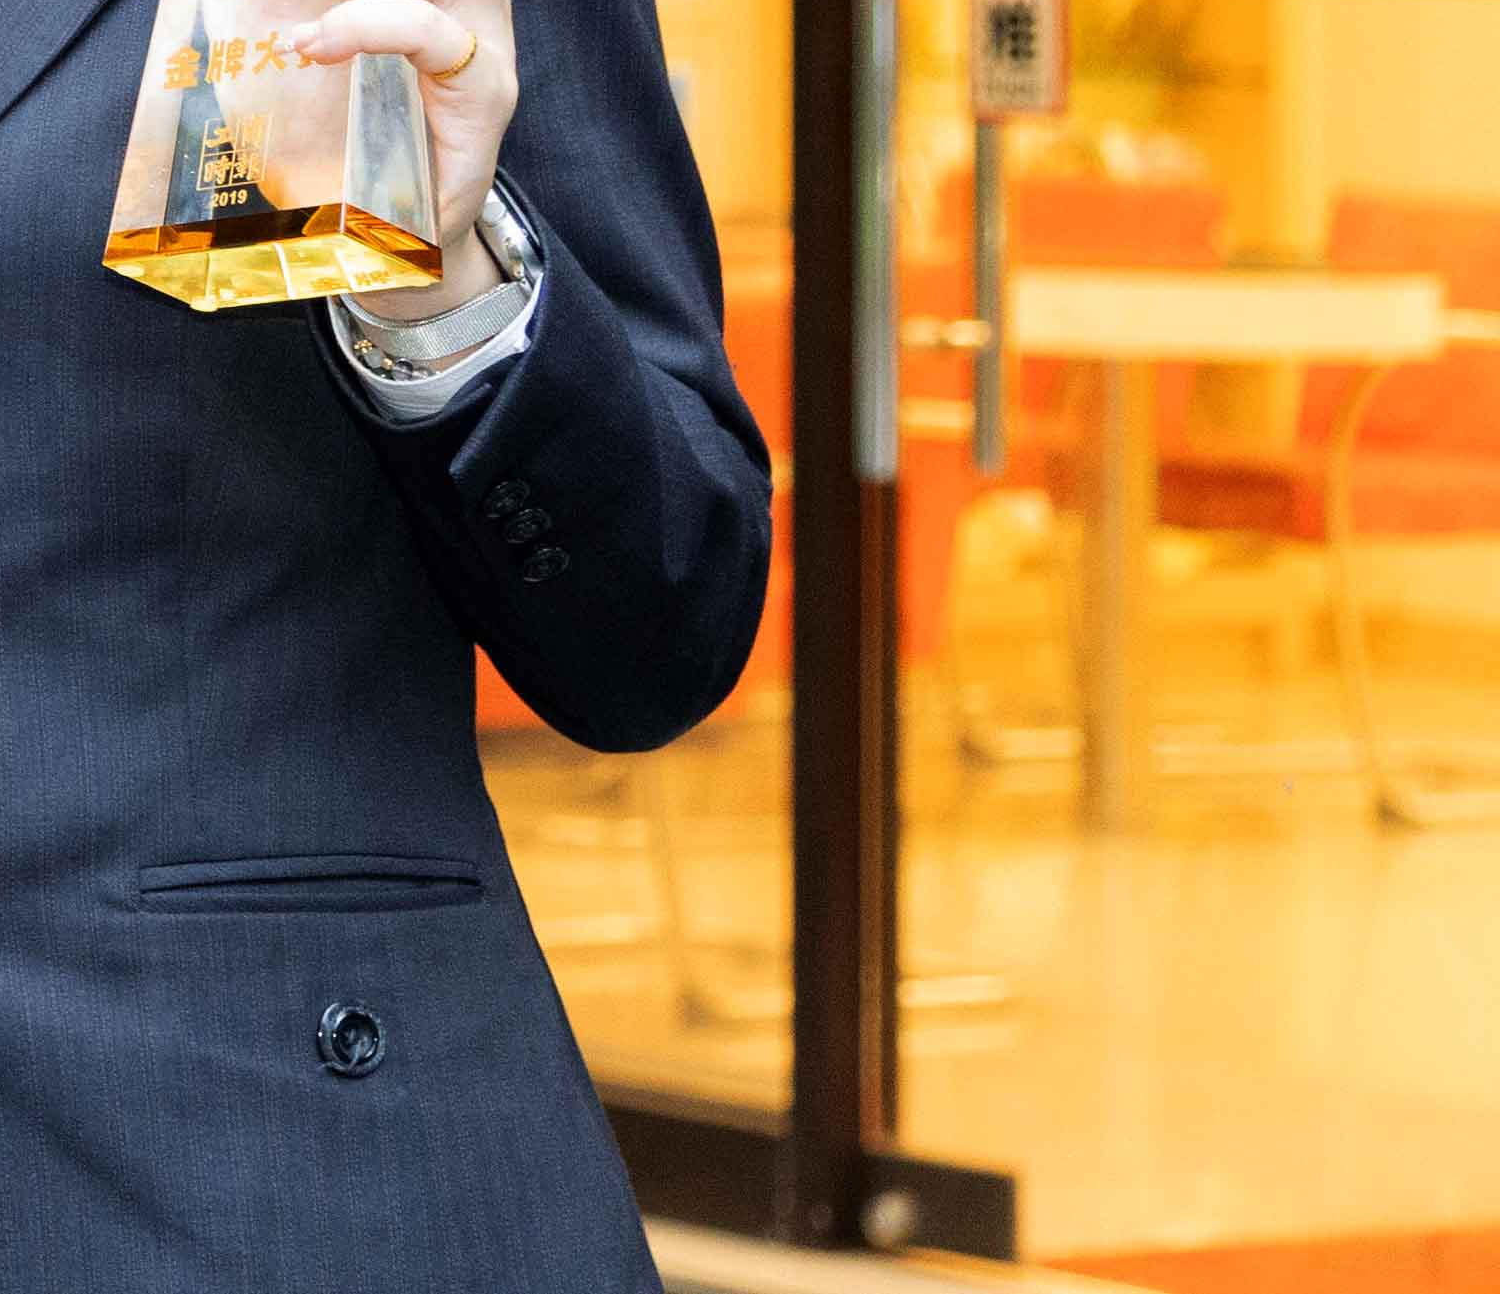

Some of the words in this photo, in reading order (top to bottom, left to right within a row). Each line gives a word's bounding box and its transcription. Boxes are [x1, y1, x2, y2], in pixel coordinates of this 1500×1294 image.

[163, 30, 313, 90] 金牌大
[211, 189, 248, 208] 2019
